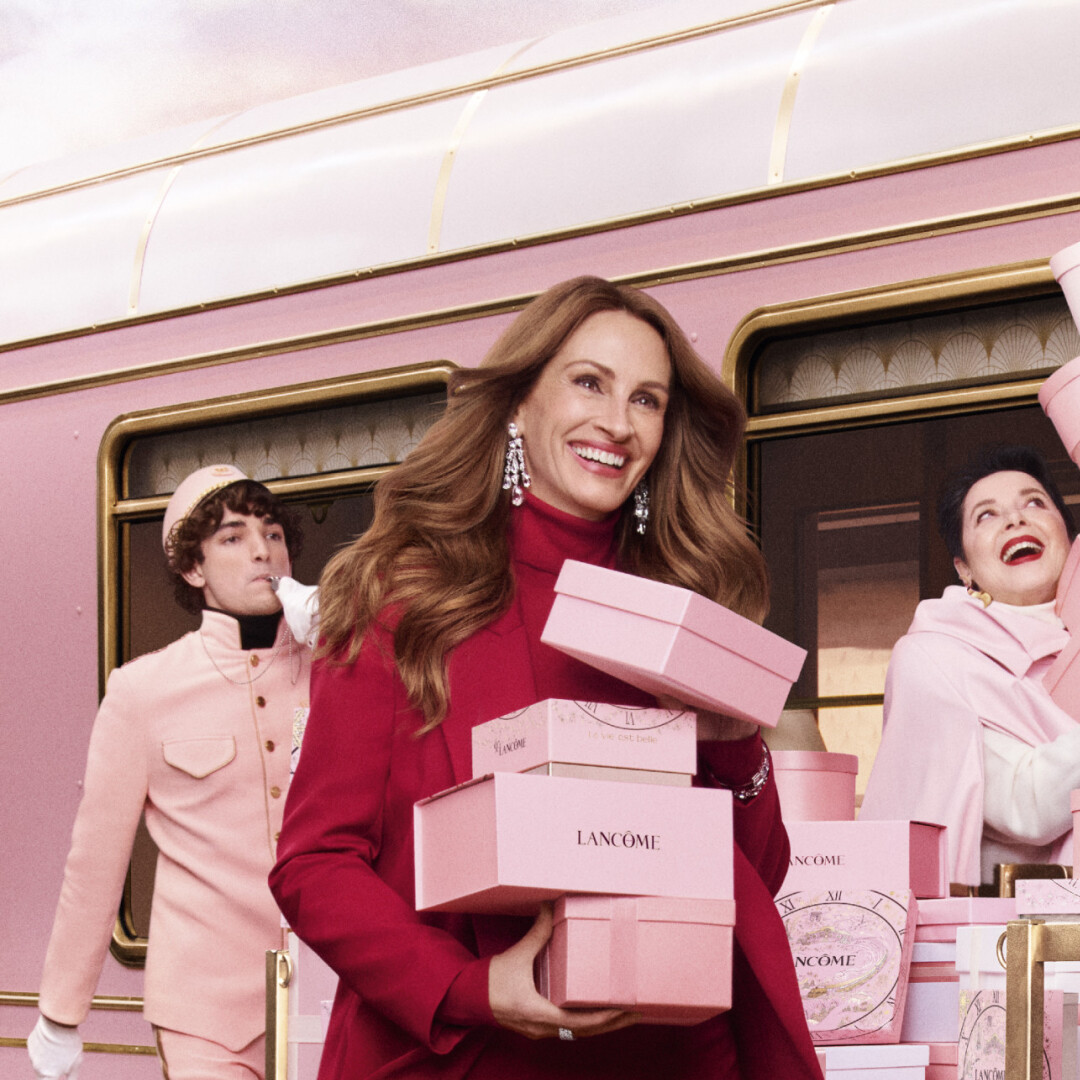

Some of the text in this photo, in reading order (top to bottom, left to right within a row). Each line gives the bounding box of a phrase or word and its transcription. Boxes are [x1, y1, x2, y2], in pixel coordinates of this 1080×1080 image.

[499, 737, 527, 757] LANCÔME
[578, 830, 661, 850] LANCÔME
[790, 853, 846, 867] NCÔME
[825, 889, 843, 902] XII
[779, 898, 796, 914] XI
[795, 953, 857, 968] NCÔME
